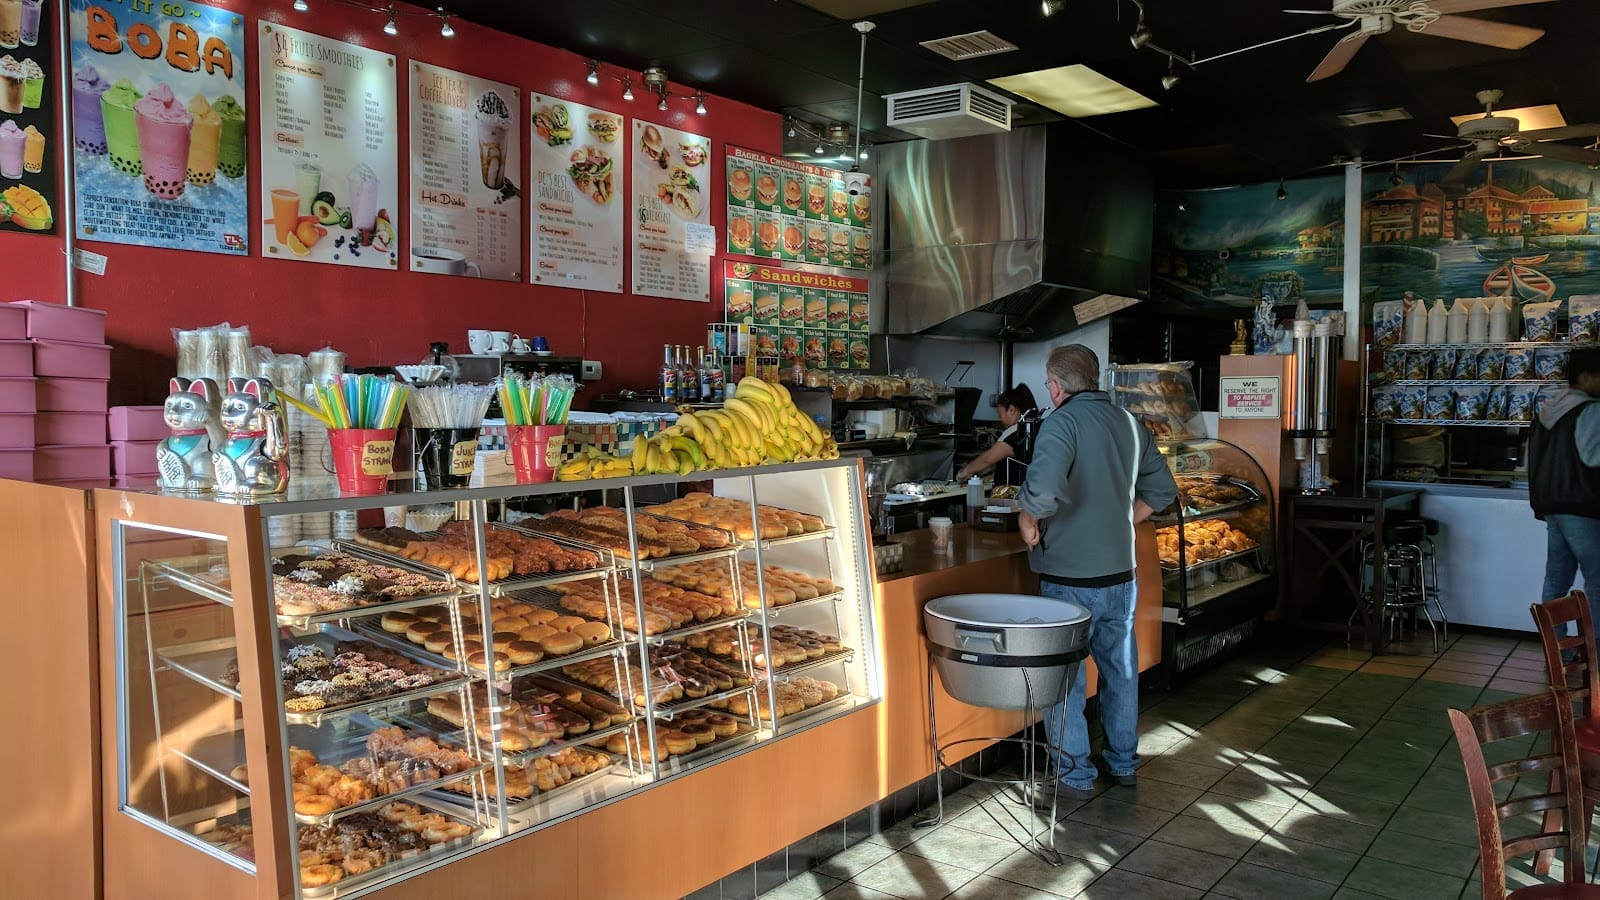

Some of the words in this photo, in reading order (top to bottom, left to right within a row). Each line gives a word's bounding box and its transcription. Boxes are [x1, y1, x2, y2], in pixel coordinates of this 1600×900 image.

[161, 2, 184, 17] GO
[87, 6, 233, 80] BOBA
[275, 32, 288, 58] $4
[291, 37, 314, 57] FRUIT
[317, 44, 364, 71] SMOOTHIES
[735, 149, 768, 164] BAGELS,
[770, 157, 813, 173] CROISSANTS
[422, 189, 437, 203] Hot
[439, 193, 465, 208] Drinks
[760, 268, 853, 289] Sandwiches
[367, 444, 391, 454] BOBA
